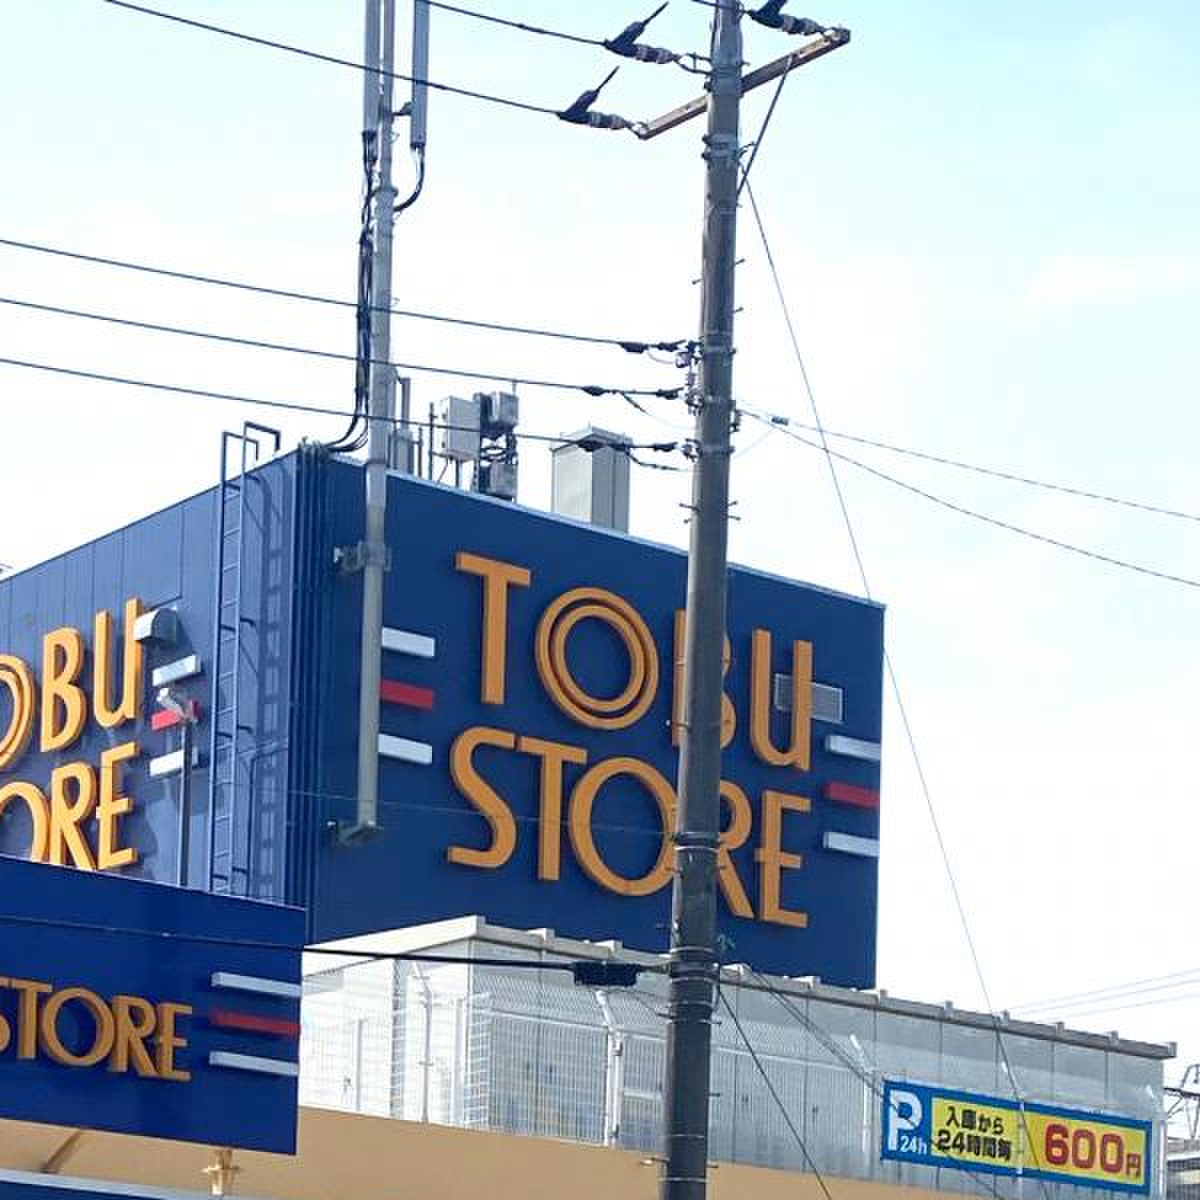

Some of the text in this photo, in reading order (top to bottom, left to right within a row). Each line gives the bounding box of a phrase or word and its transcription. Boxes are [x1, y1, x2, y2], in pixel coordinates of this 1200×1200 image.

[447, 726, 811, 928] STORE
[946, 1105, 1004, 1134] 入庫から
[899, 1135, 928, 1155] 24h
[934, 1129, 1012, 1161] 24時間毎
[1044, 1123, 1142, 1178] 600円
